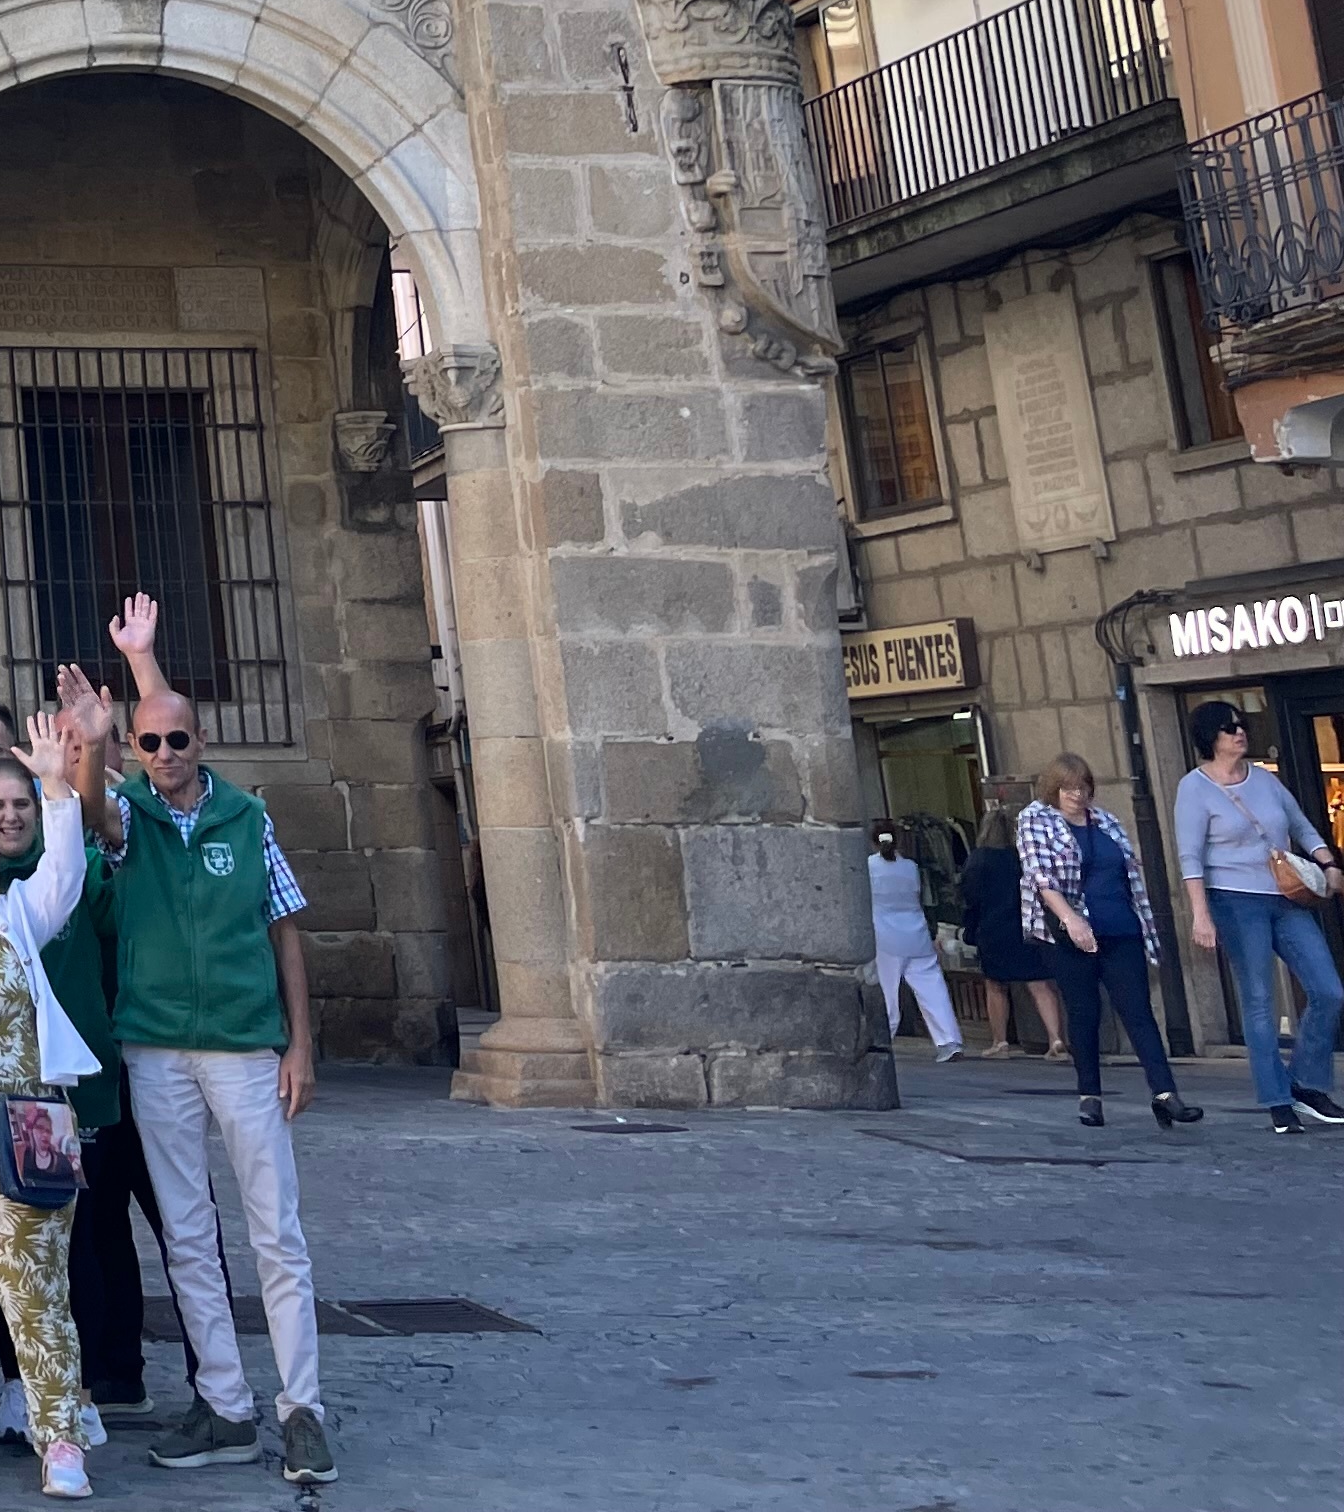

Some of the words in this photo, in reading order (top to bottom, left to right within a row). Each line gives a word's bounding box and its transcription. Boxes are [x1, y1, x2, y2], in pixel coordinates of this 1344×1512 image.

[1169, 595, 1309, 656] MISAKO
[842, 643, 880, 687] ESUS
[883, 633, 958, 683] FUENTES
